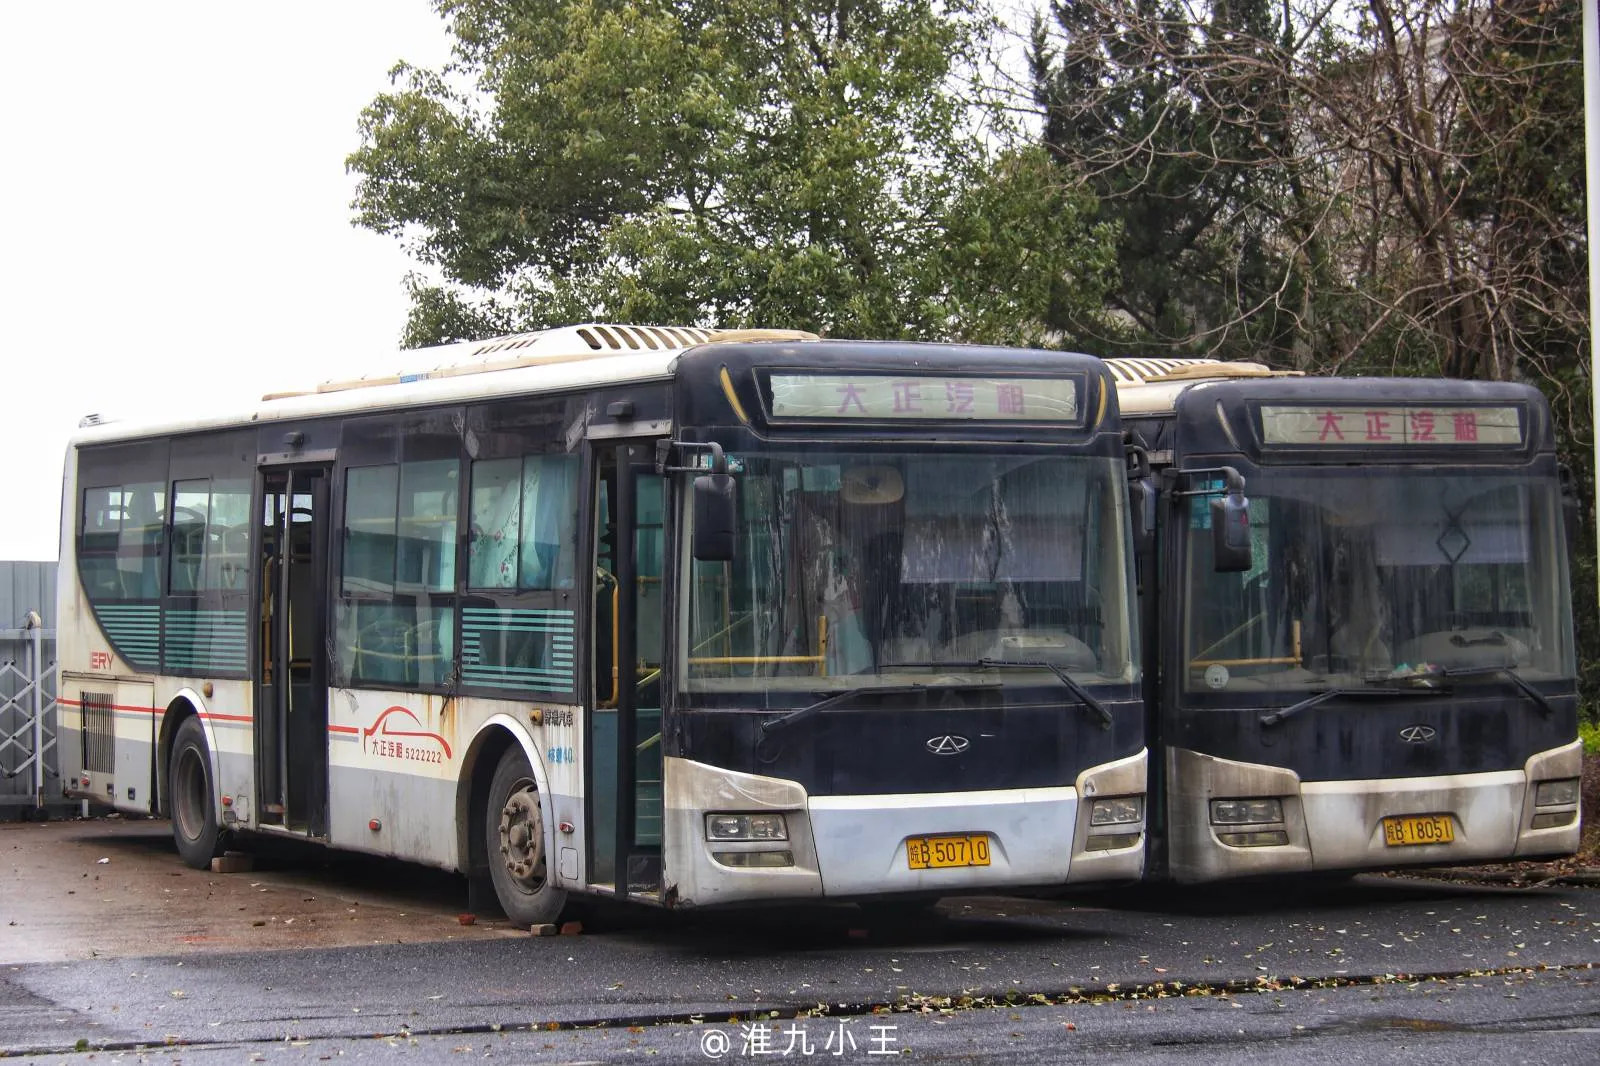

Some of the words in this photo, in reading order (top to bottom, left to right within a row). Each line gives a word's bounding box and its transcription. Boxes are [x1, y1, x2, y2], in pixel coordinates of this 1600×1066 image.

[835, 381, 1025, 414] 大正汽租
[1315, 410, 1479, 441] 大正汽租
[405, 747, 442, 763] 5222222
